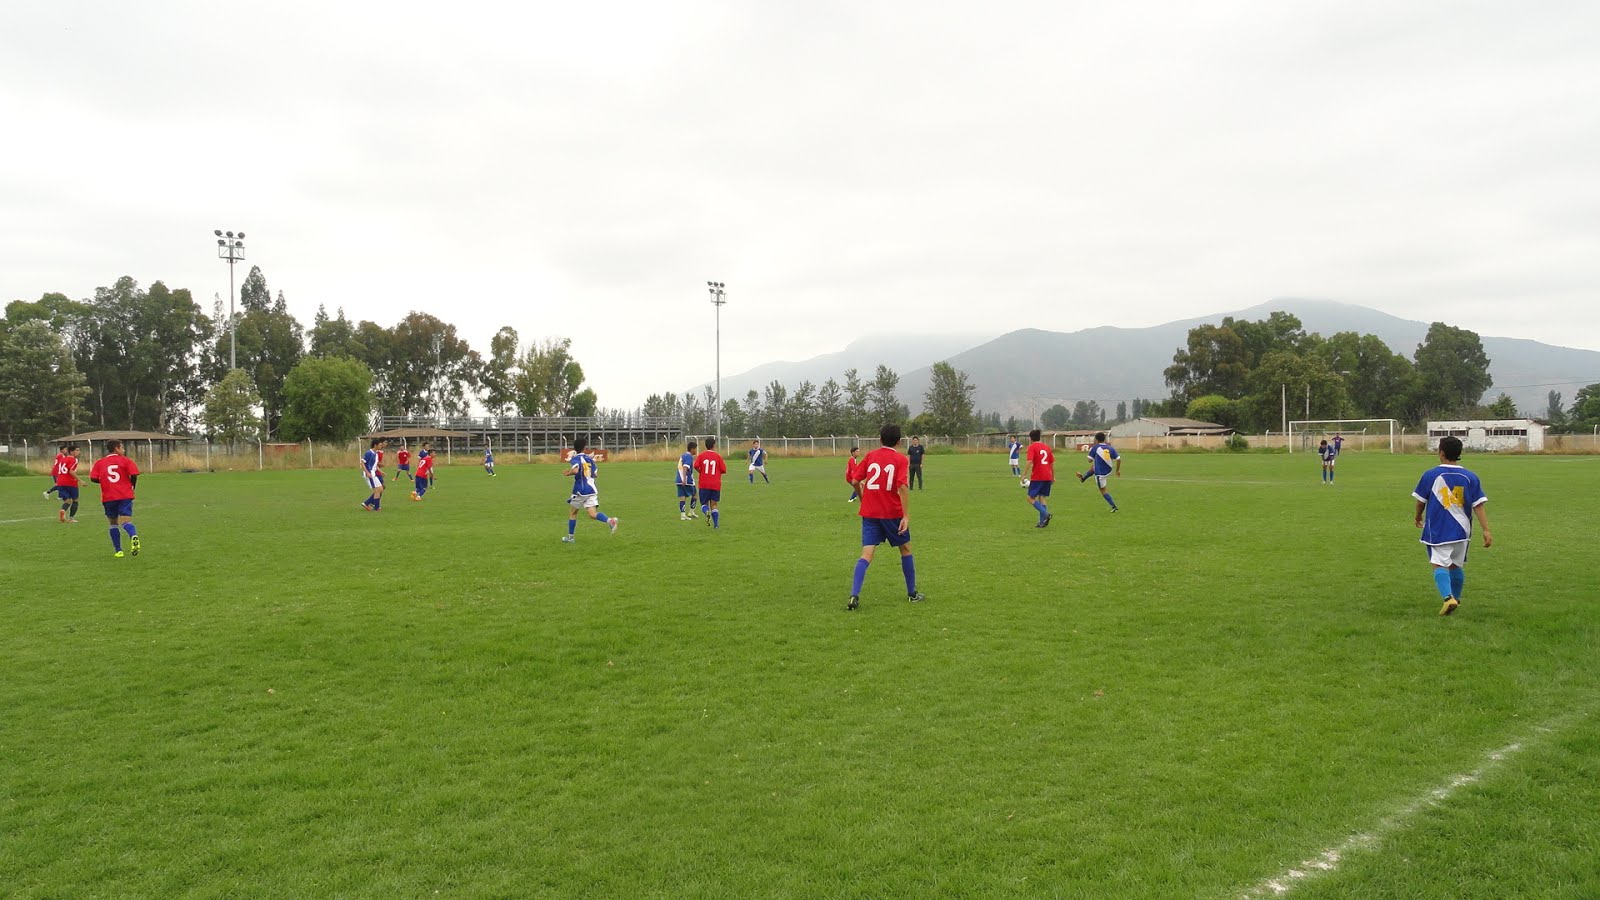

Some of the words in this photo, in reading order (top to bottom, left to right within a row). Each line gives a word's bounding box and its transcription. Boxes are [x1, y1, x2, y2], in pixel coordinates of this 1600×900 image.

[1040, 449, 1048, 465] 2
[58, 462, 68, 474] 16
[107, 464, 121, 483] 5
[703, 459, 717, 475] 11
[866, 462, 895, 491] 21
[1439, 485, 1465, 508] 14
